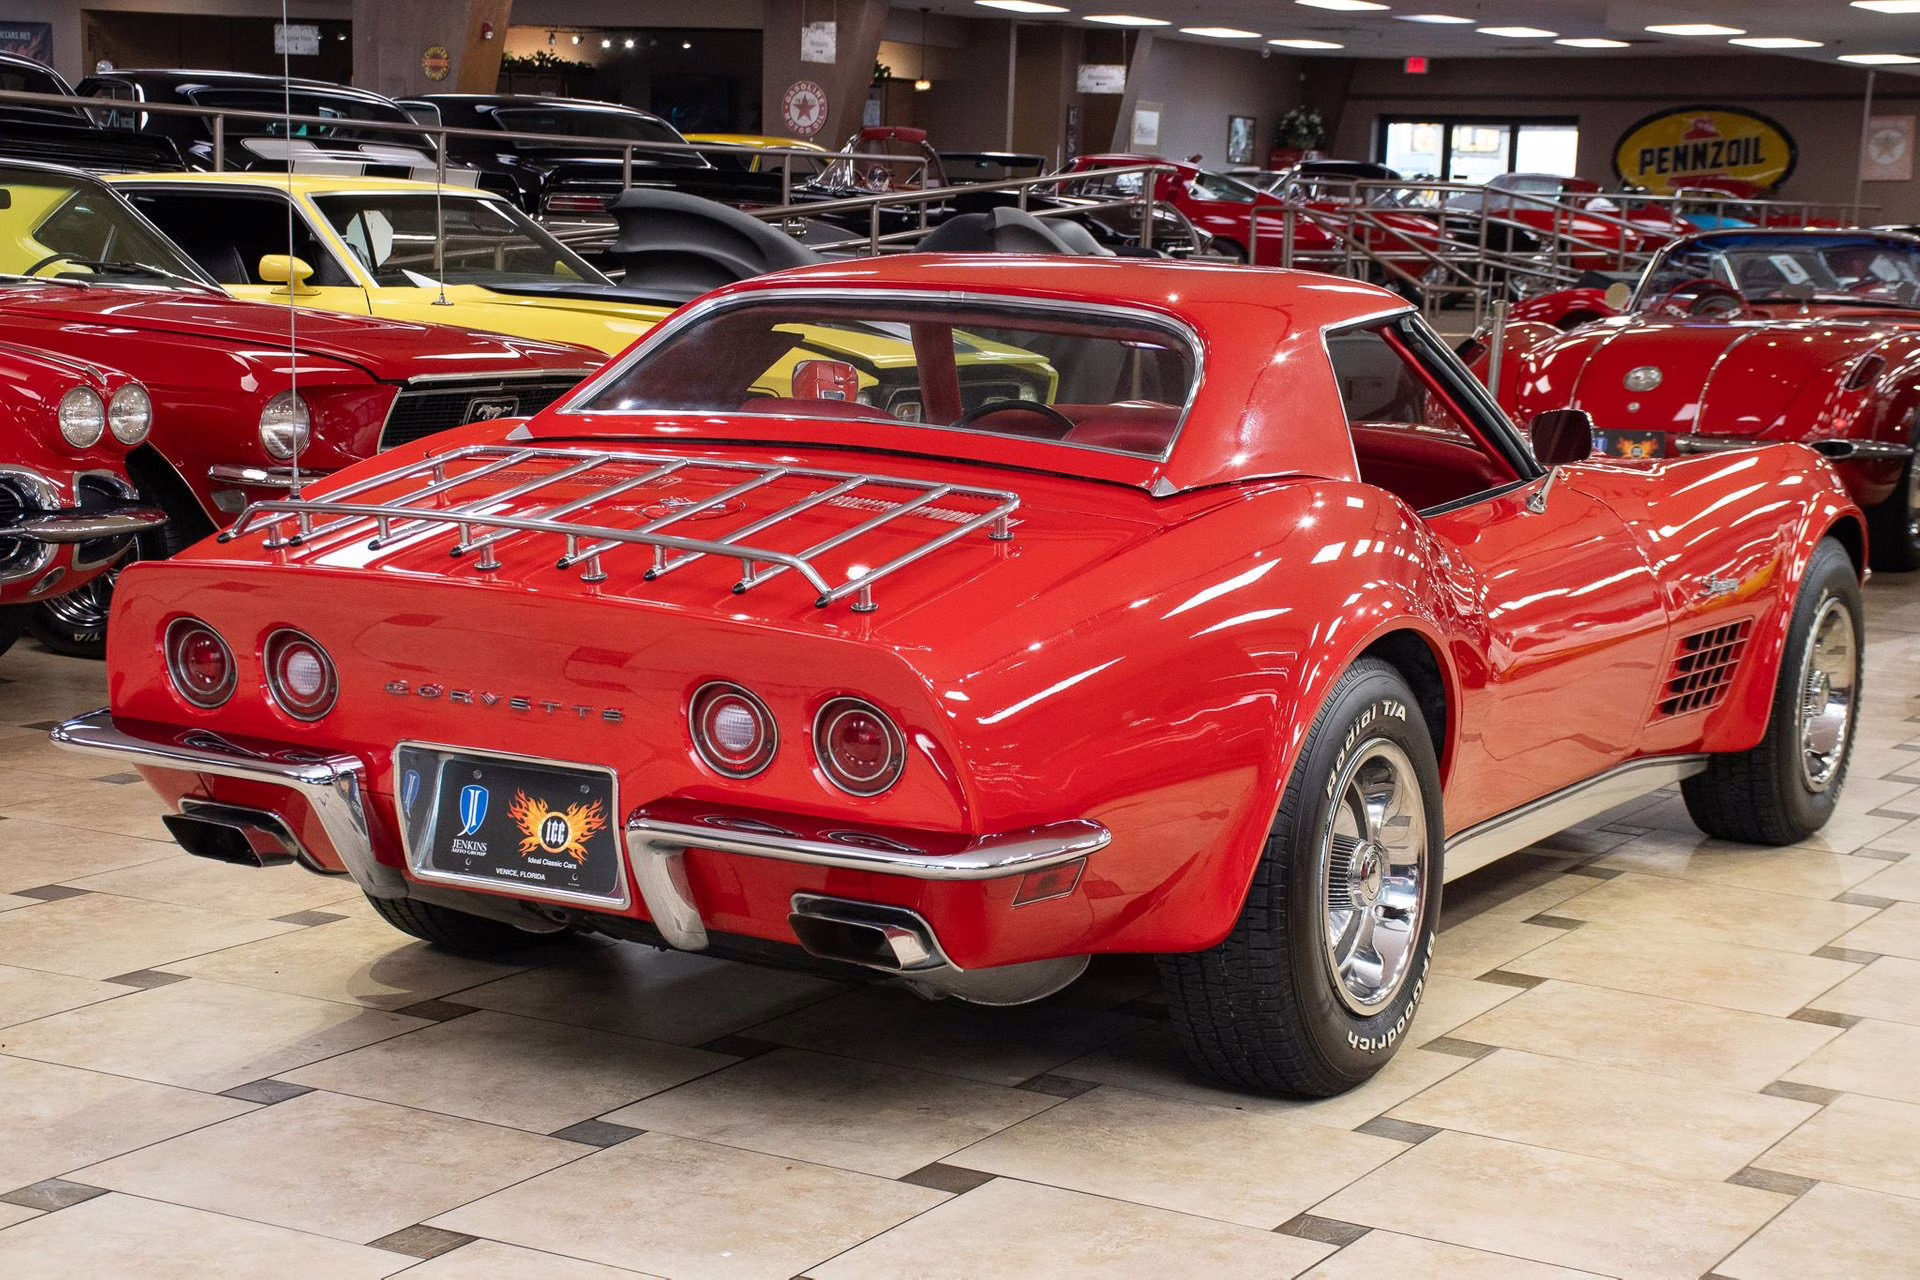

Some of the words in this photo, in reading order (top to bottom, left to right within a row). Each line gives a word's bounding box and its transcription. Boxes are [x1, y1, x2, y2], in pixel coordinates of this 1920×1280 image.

[785, 83, 825, 104] GASOLINE
[785, 112, 812, 134] MOTOR
[813, 114, 825, 130] OIL
[1639, 136, 1767, 176] PENNZOIL
[385, 680, 625, 722] CORVETTE
[1327, 703, 1377, 800] Radial
[1382, 700, 1406, 721] T/A
[452, 839, 488, 852] JENKINS
[528, 856, 541, 865] Ideal
[543, 858, 563, 868] Classic
[564, 860, 577, 870] Cars
[495, 867, 519, 878] VENICE,
[520, 871, 546, 881] FLORIDA
